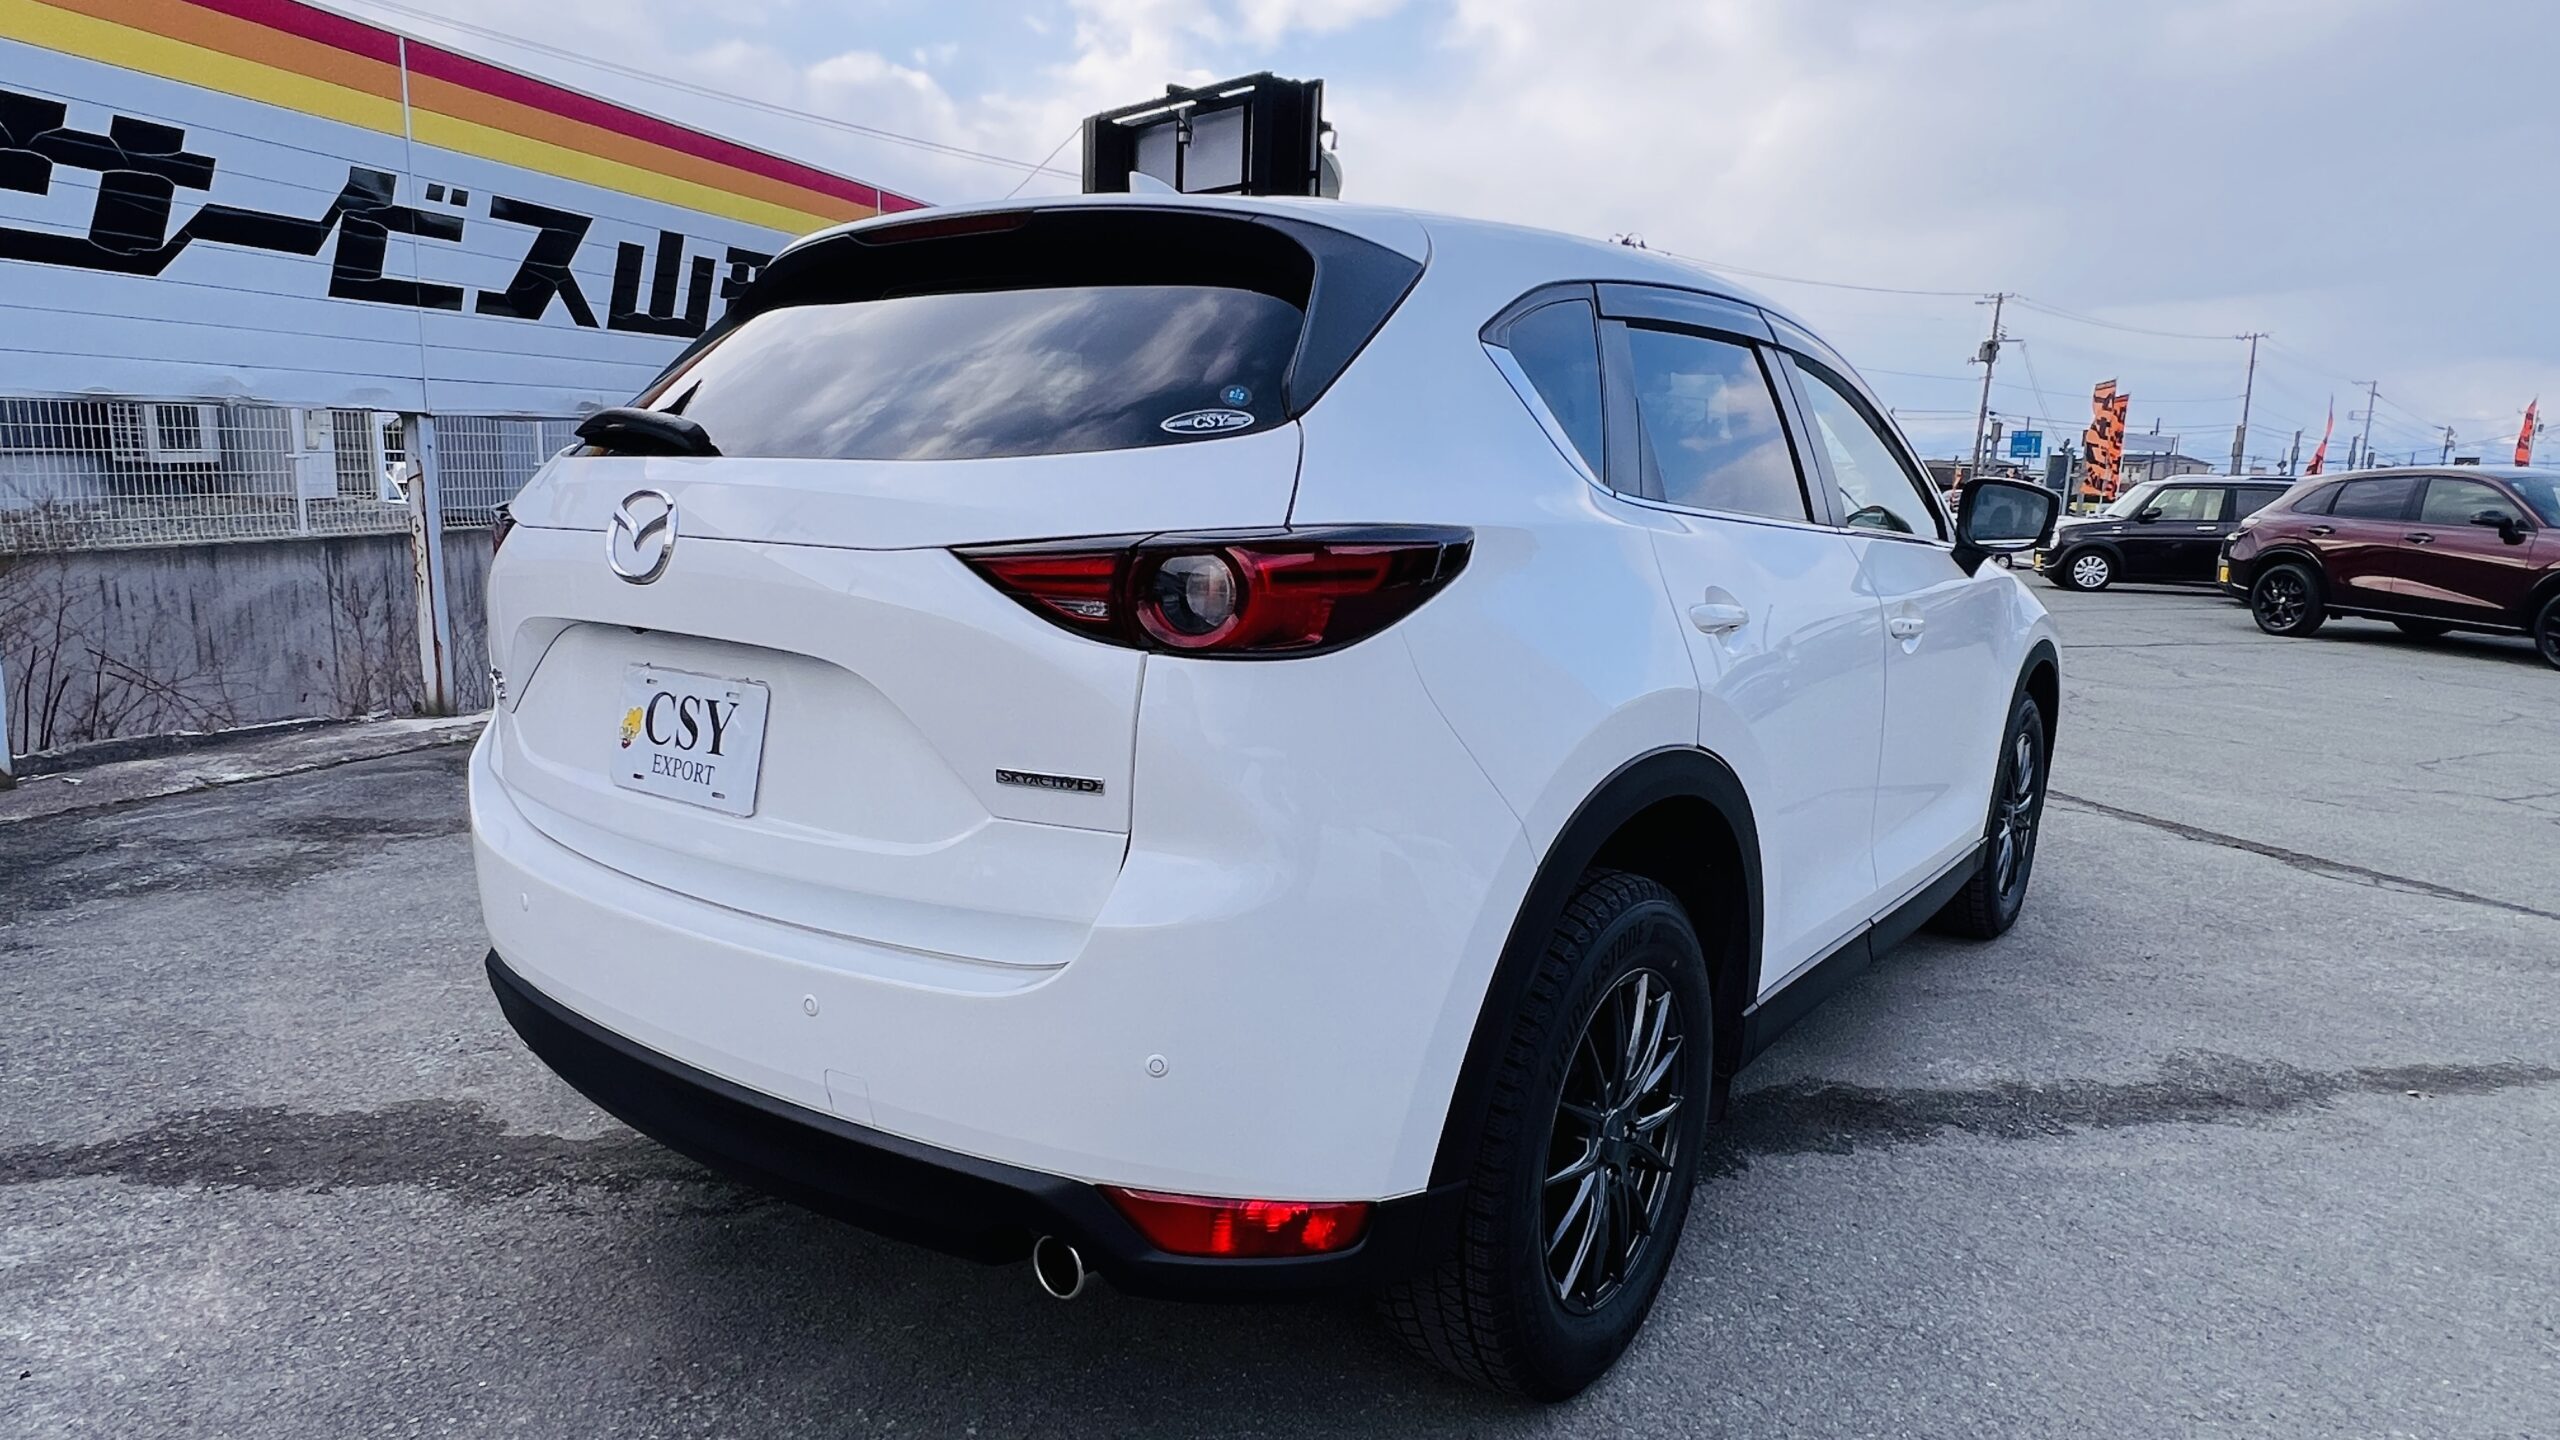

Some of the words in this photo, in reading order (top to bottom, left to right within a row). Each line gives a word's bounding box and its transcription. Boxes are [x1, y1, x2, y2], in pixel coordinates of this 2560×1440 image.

[1193, 415, 1230, 429] CSY
[645, 691, 739, 757] CSY
[651, 753, 716, 786] EXPORT
